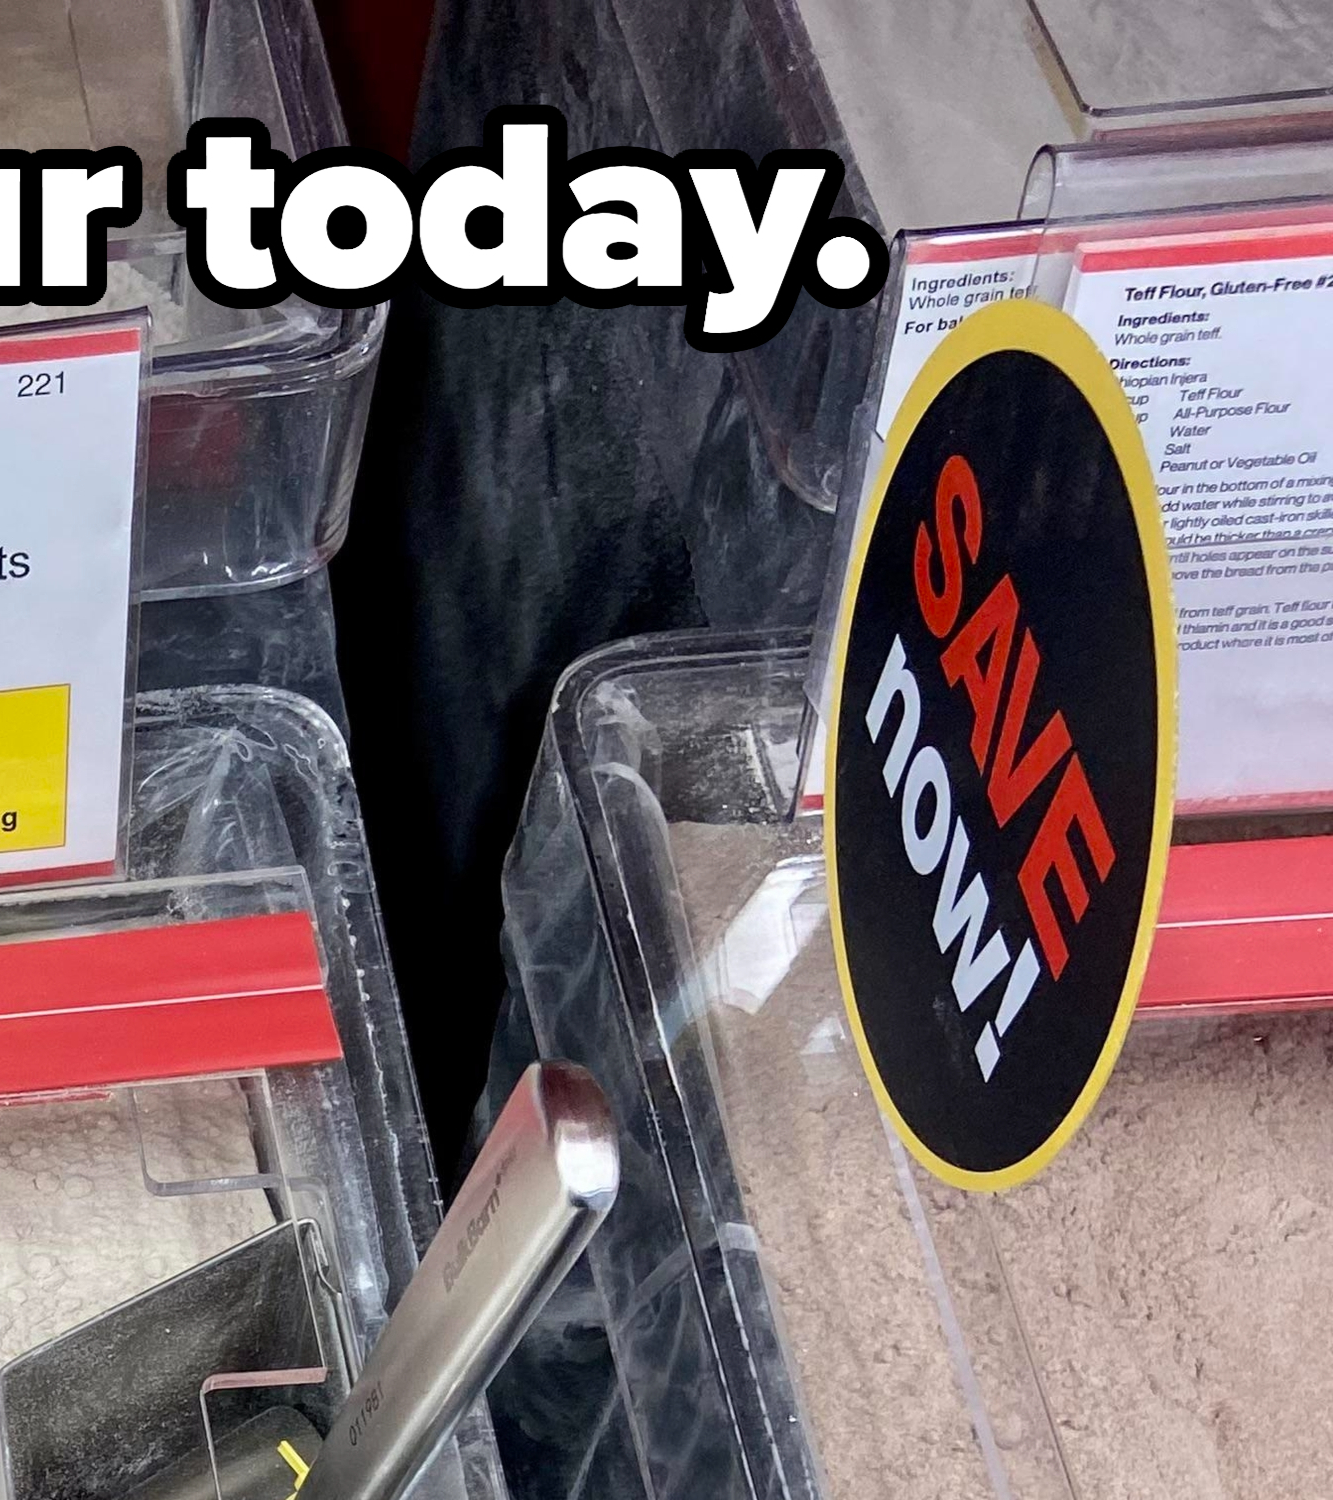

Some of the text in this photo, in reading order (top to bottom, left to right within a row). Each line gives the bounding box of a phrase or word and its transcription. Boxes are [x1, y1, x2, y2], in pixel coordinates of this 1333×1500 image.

[911, 270, 1014, 294] Ingredients:
[1126, 285, 1157, 301] Teff
[1157, 284, 1206, 299] Flour,
[1209, 277, 1312, 295] Gluten-Free
[909, 293, 959, 310] Whole
[963, 288, 1004, 307] grain
[903, 320, 933, 334] For
[1117, 311, 1210, 328] Ingredients:
[1114, 326, 1221, 346] Whole grain teff.
[1109, 356, 1190, 371] Directions:
[18, 372, 63, 397] 221
[1180, 387, 1207, 402] Teff
[1206, 386, 1244, 400] Flour
[1170, 425, 1212, 437] Water
[1163, 442, 1191, 455] Salt
[1158, 451, 1317, 473] Peanut or Vegetable Oil
[913, 455, 1116, 982] SAVE
[2, 812, 16, 831] g
[865, 633, 1041, 1084] now!
